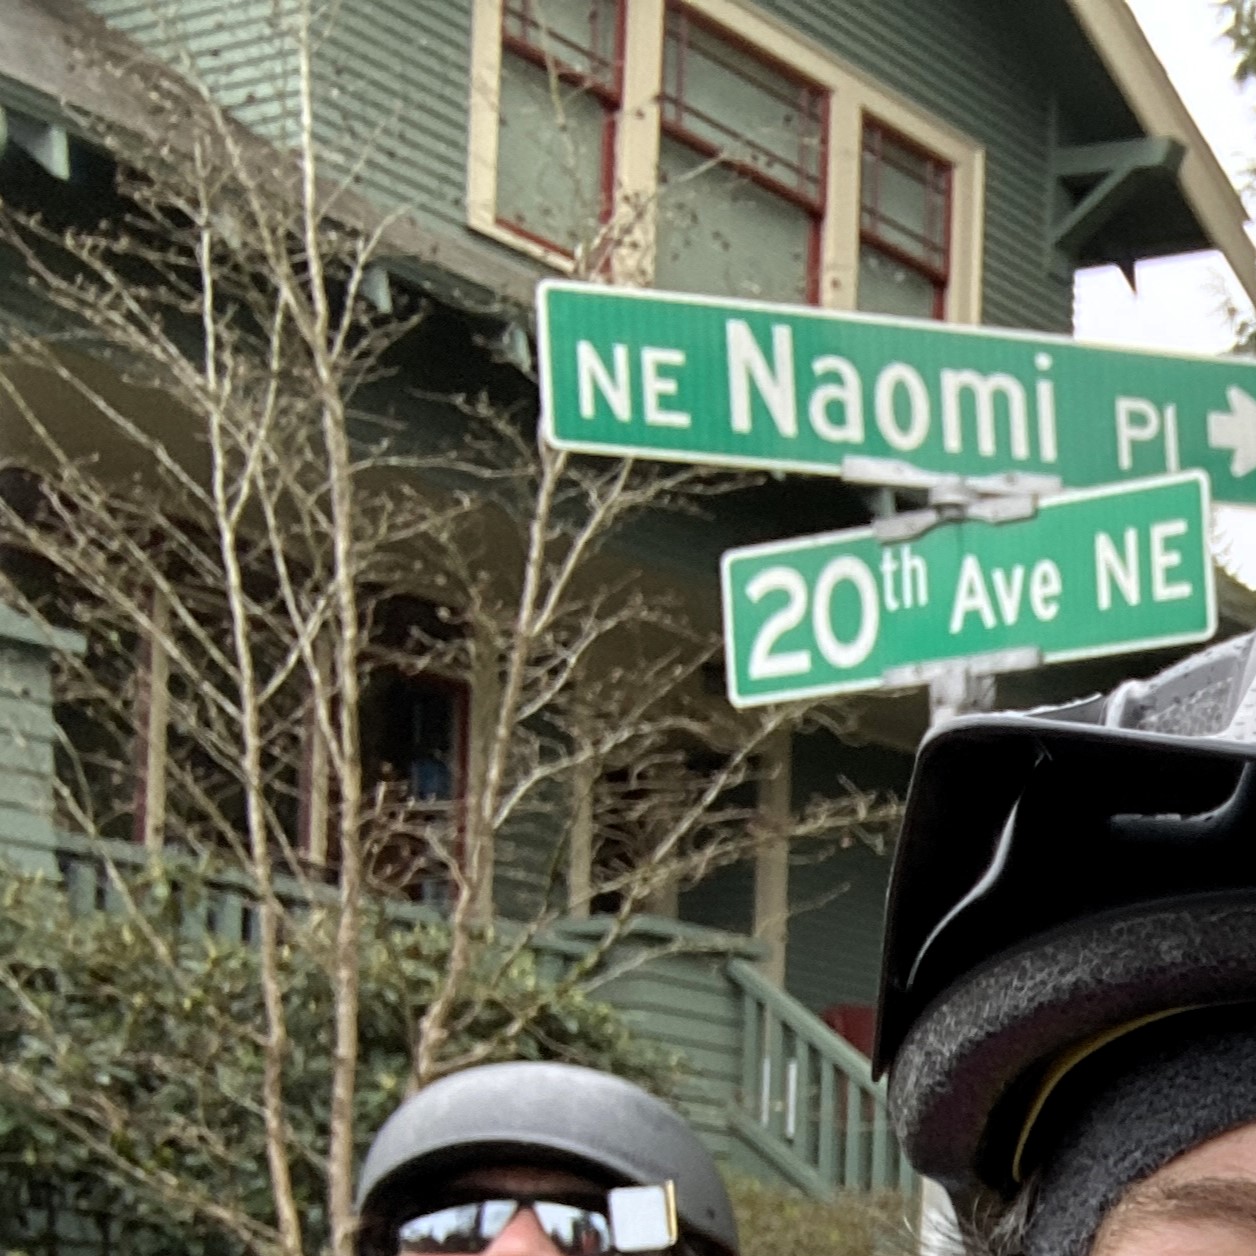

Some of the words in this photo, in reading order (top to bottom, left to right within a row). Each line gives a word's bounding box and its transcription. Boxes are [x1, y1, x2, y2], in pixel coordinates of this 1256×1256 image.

[577, 339, 691, 427] NE
[726, 319, 1058, 462] Naomi
[1115, 397, 1179, 474] Pl
[745, 545, 928, 679] 20th
[949, 555, 1063, 634] Ave
[1095, 519, 1193, 610] NE
